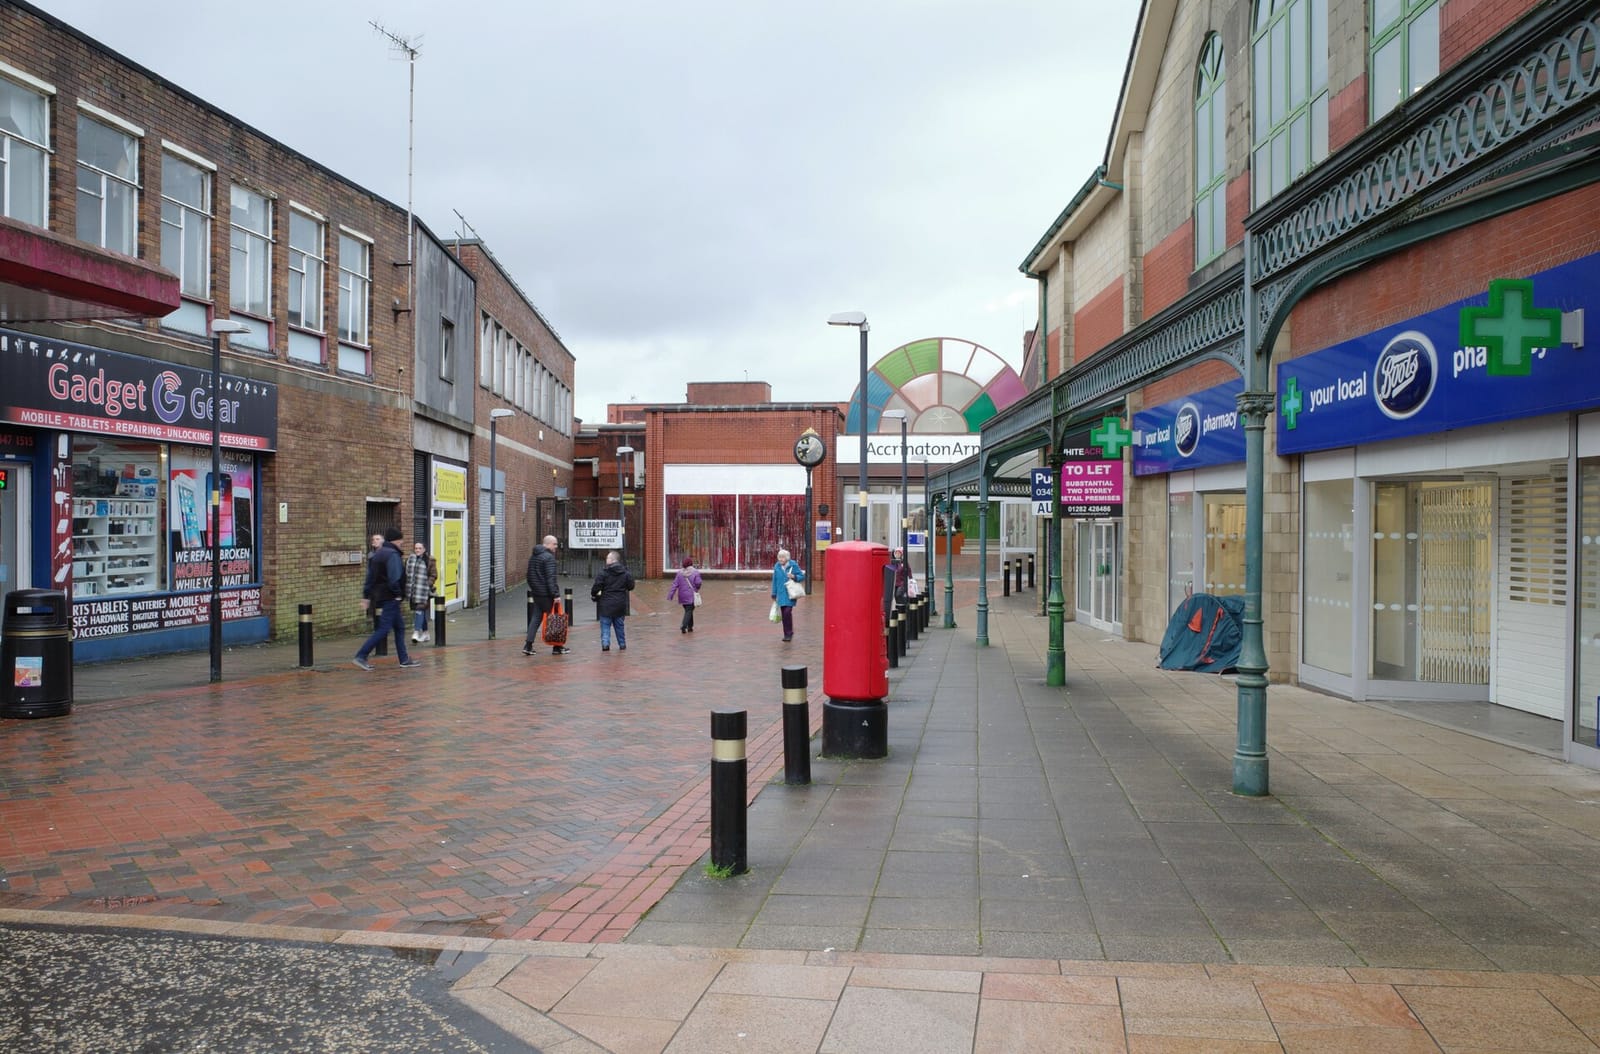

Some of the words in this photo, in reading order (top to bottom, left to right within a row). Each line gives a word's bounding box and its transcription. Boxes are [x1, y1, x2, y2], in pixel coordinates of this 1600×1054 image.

[1309, 384, 1335, 412] your
[1338, 370, 1367, 400] local
[1379, 348, 1419, 401] Boots
[48, 362, 147, 416] Gadget
[190, 387, 240, 424] Gear
[21, 410, 61, 425] MOBILE
[68, 416, 110, 431] TABLETS
[115, 422, 162, 436] REPAIRING
[167, 429, 210, 441] UNLOCKING
[219, 434, 258, 447] CCESSORIES
[1145, 431, 1157, 448] your
[1158, 424, 1171, 443] local
[1202, 411, 1238, 436] pharmacy
[1063, 447, 1104, 456] HITEACR
[1035, 472, 1053, 485] Pu
[1066, 465, 1083, 475] TO
[1087, 464, 1112, 475] LET
[175, 551, 189, 563] WE
[190, 549, 213, 562] REPAI
[219, 547, 250, 560] BROKEN
[175, 562, 213, 578] MOBILE
[219, 560, 250, 575] CREEN
[176, 577, 200, 590] WHILE
[222, 575, 241, 587] WAIT
[72, 603, 90, 616] RTS
[91, 600, 129, 615] TABLETS
[132, 600, 167, 611] BATTERIES
[169, 595, 200, 609] MOBILE
[72, 616, 88, 628] SES
[90, 612, 129, 625] HARDWARE
[132, 611, 159, 621] DIGITIZER
[161, 607, 197, 619] UNLOCKING
[78, 623, 129, 638] ACCESSORIES
[132, 621, 159, 631] CHARGING
